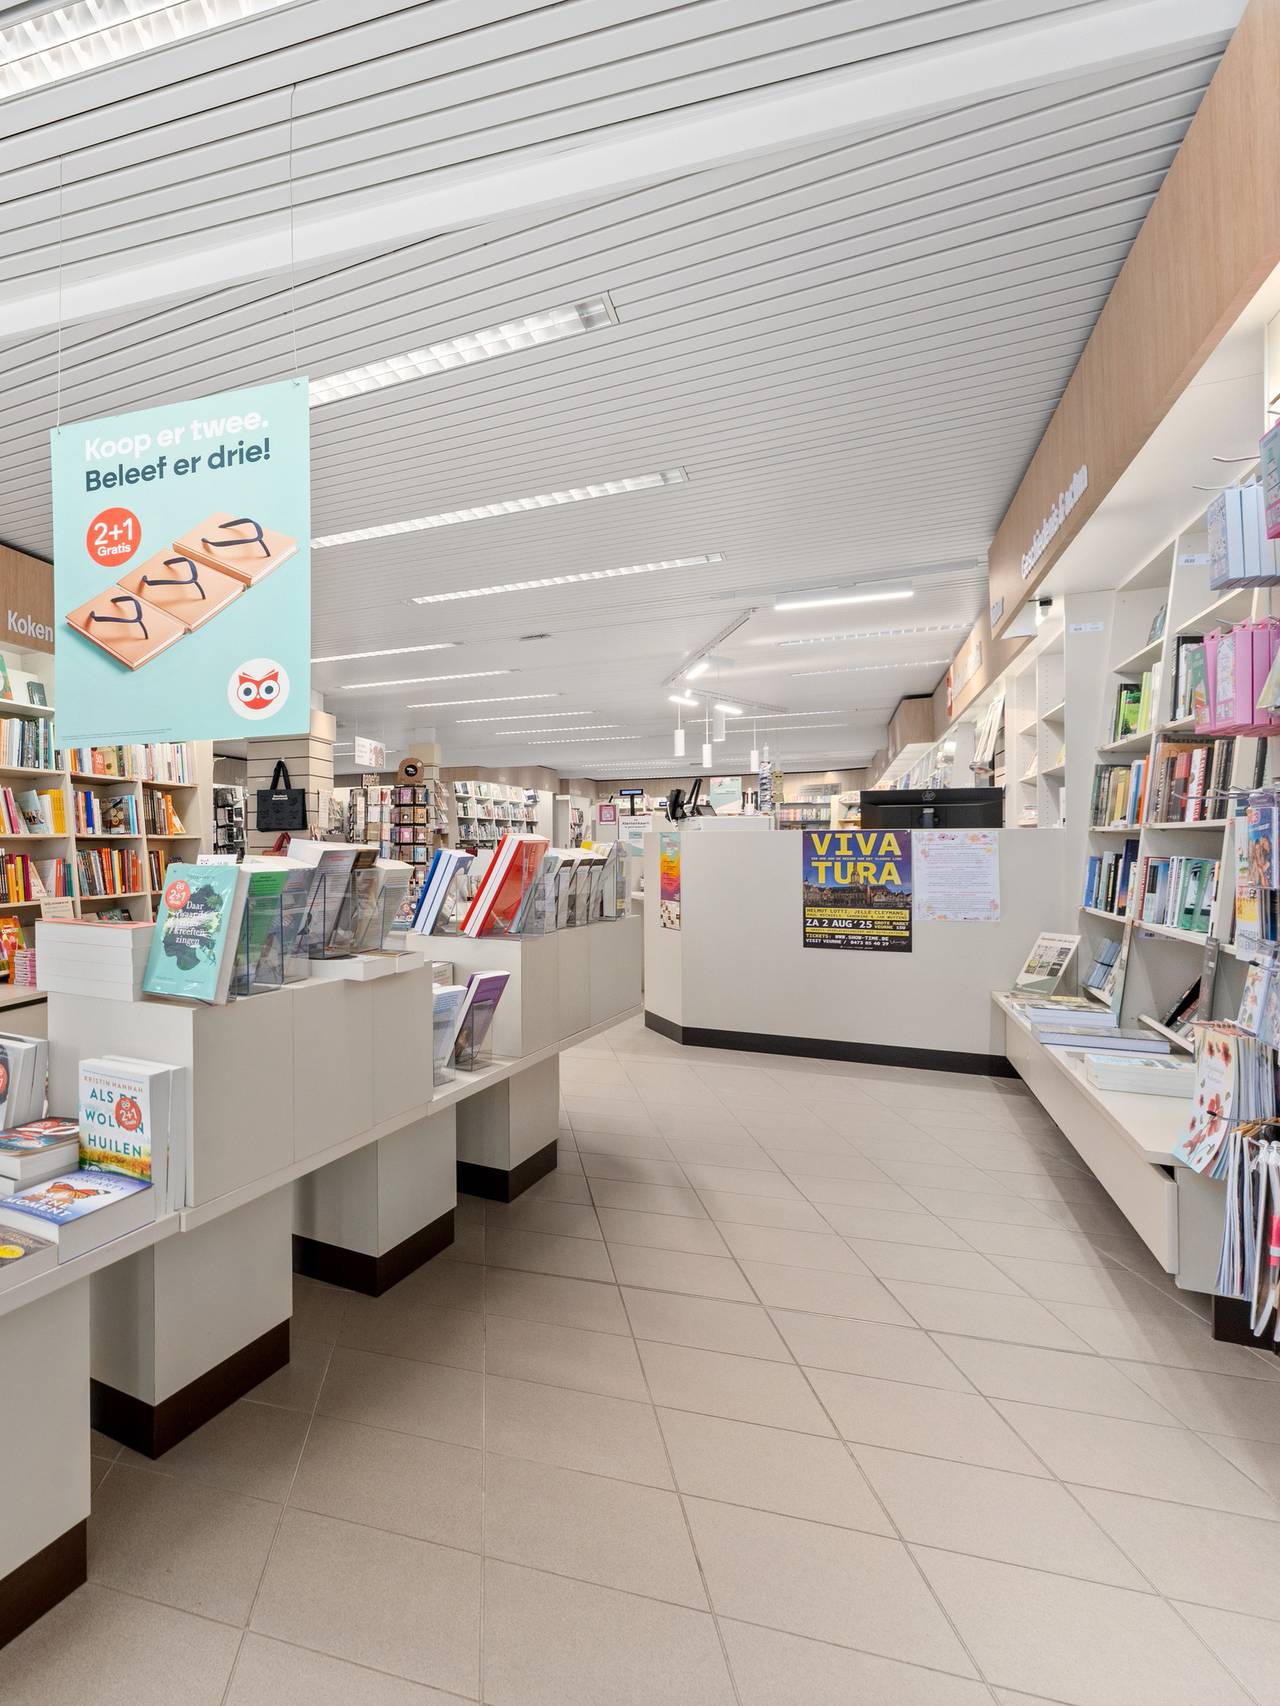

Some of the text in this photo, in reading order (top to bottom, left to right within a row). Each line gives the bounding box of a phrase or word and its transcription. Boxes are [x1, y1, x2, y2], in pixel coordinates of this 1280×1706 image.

[85, 411, 269, 461] Koop er twee.
[86, 437, 270, 491] Beleef er drie!
[94, 517, 133, 546] 2+1
[97, 543, 131, 557] Gratis
[8, 610, 53, 641] Koken
[811, 832, 902, 856] VIVA
[811, 861, 902, 885] TURA
[186, 901, 204, 910] Daar
[175, 937, 200, 946] zingen
[90, 1088, 114, 1103] ALS
[120, 1108, 137, 1121] 2+1
[88, 1133, 142, 1157] HUILEN
[3, 1198, 72, 1217] MOMENT
